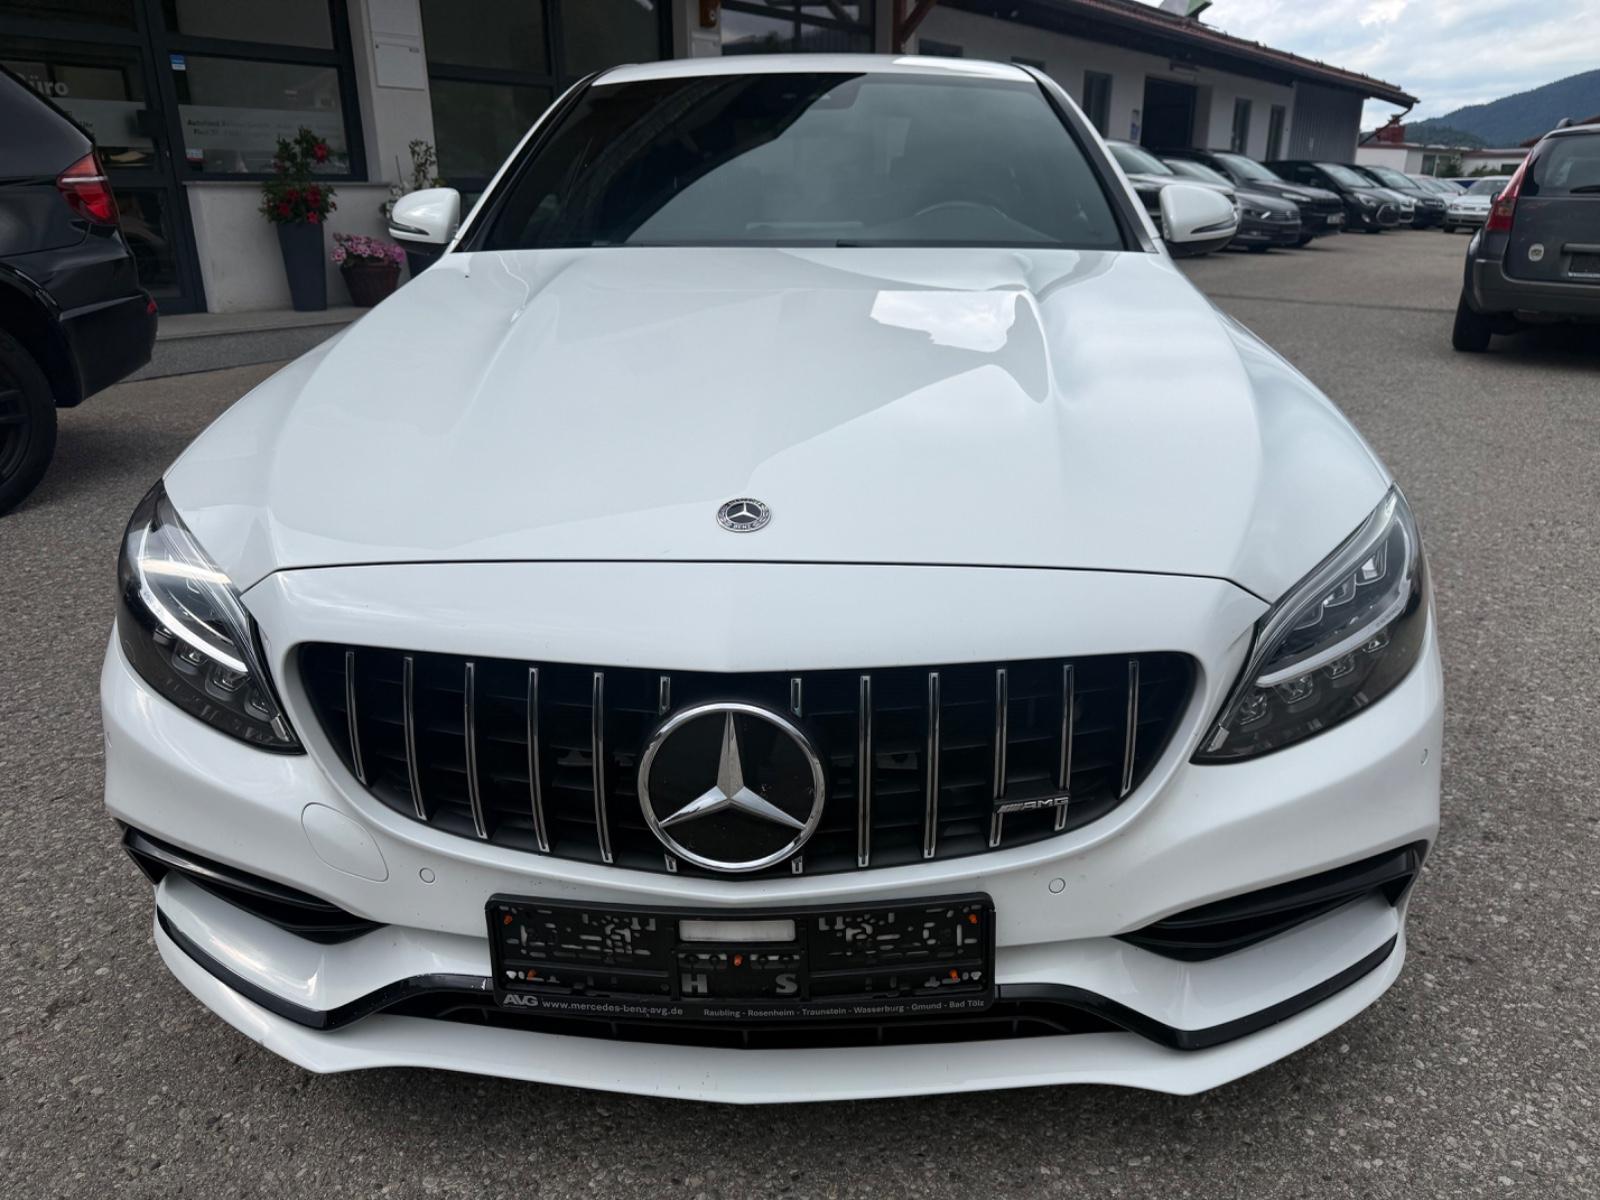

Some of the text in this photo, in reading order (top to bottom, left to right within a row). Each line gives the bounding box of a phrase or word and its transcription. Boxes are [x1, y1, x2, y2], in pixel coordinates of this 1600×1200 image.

[16, 72, 69, 96] üro
[503, 994, 539, 1007] AVG
[541, 1000, 684, 1017] www.mercedes-benz-avg.de
[703, 1008, 741, 1018] Raubling
[747, 1009, 795, 1017] Rosenheim
[801, 1008, 847, 1016] Traunstein
[853, 1005, 905, 1014] Wasserburg
[911, 1002, 942, 1010] Gmund
[949, 1000, 966, 1008] Bad
